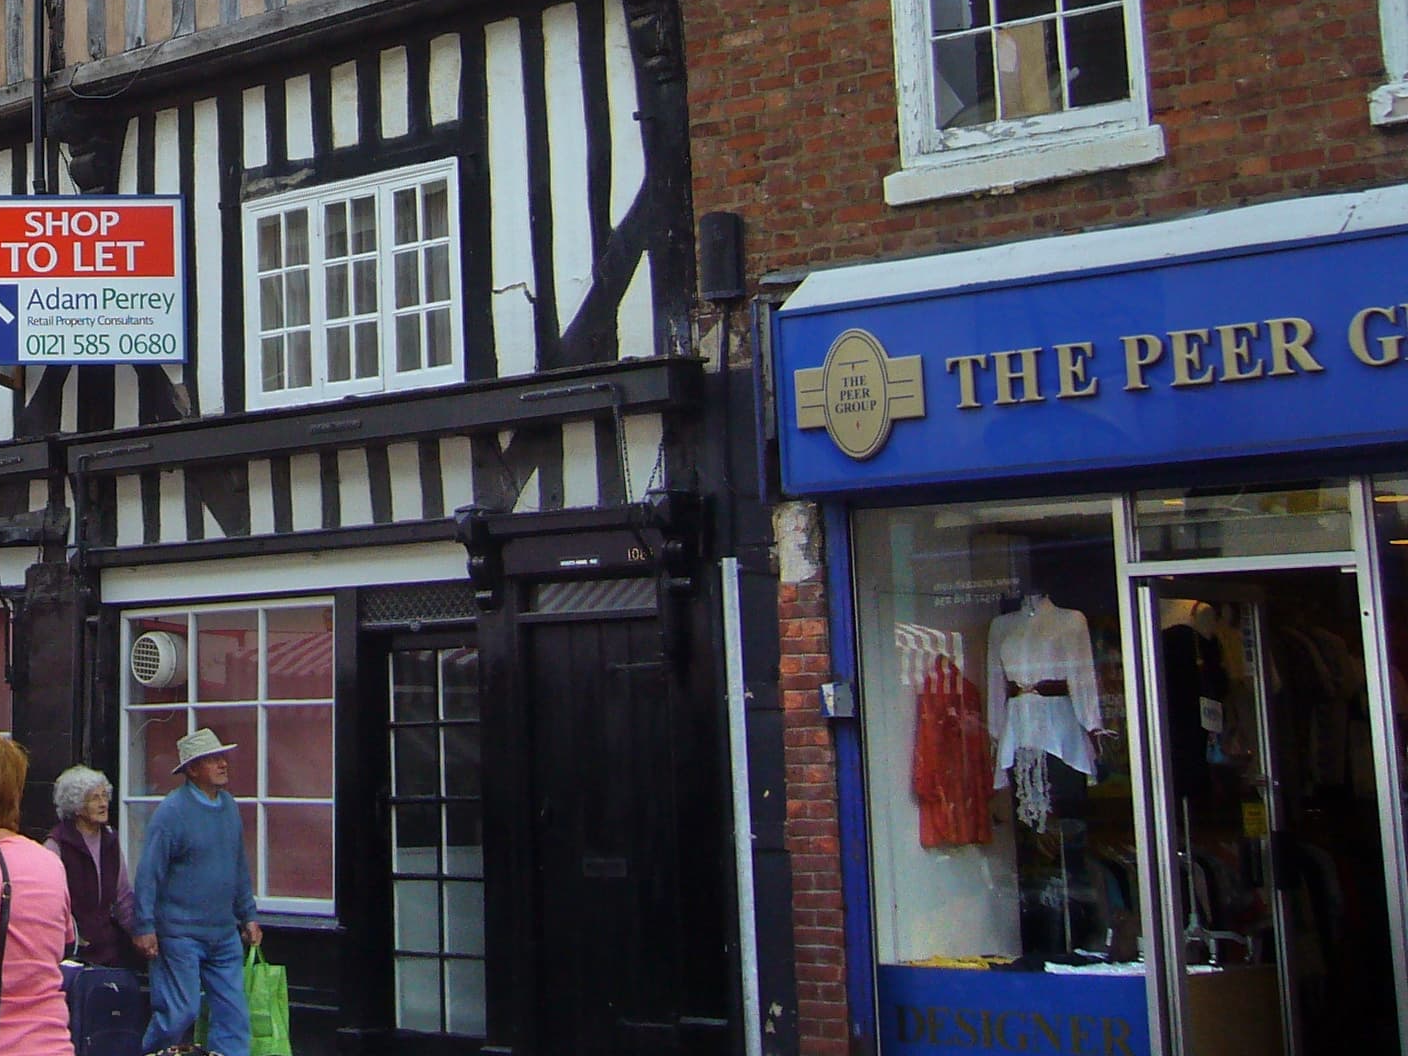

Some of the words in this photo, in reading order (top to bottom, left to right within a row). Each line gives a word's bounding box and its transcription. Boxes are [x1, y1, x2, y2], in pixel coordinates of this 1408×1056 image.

[24, 210, 120, 237] SHOP
[0, 241, 59, 273] TO
[73, 240, 145, 272] LET
[26, 286, 98, 311] Adam
[102, 287, 176, 315] Perrey
[27, 315, 54, 326] Retail
[56, 315, 96, 328] Property
[97, 315, 154, 326] Consultants
[26, 334, 65, 356] 0121
[73, 334, 110, 356] 585
[119, 333, 177, 356] 0680
[945, 340, 1100, 410] THE
[1119, 316, 1324, 392] PEER
[1348, 303, 1408, 367] G
[841, 375, 868, 387] THE
[834, 399, 877, 414] GROUP
[840, 387, 871, 401] PEER
[895, 1004, 1137, 1056] DESIGNER
